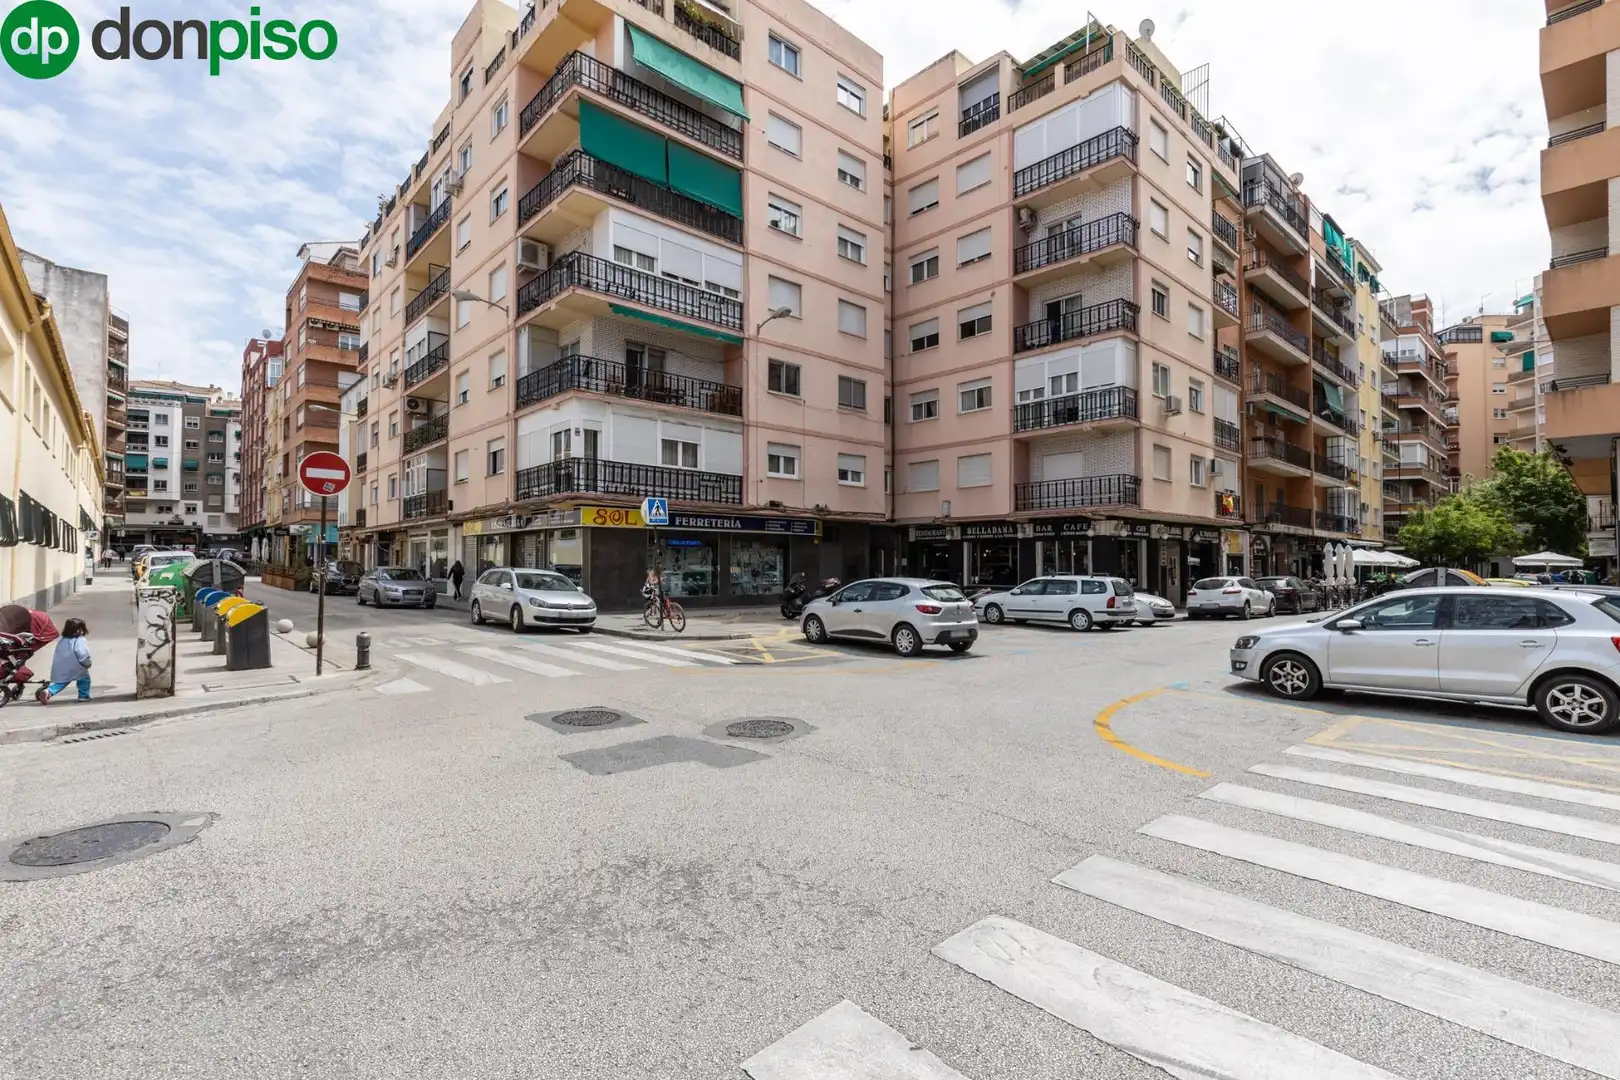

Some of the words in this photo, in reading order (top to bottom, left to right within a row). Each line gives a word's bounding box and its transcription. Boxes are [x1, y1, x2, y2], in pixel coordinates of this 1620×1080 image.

[593, 508, 638, 526] SOL
[675, 516, 742, 529] FERRETERÍA
[966, 525, 1013, 535] BELLADAMA
[1035, 524, 1053, 532] BAR
